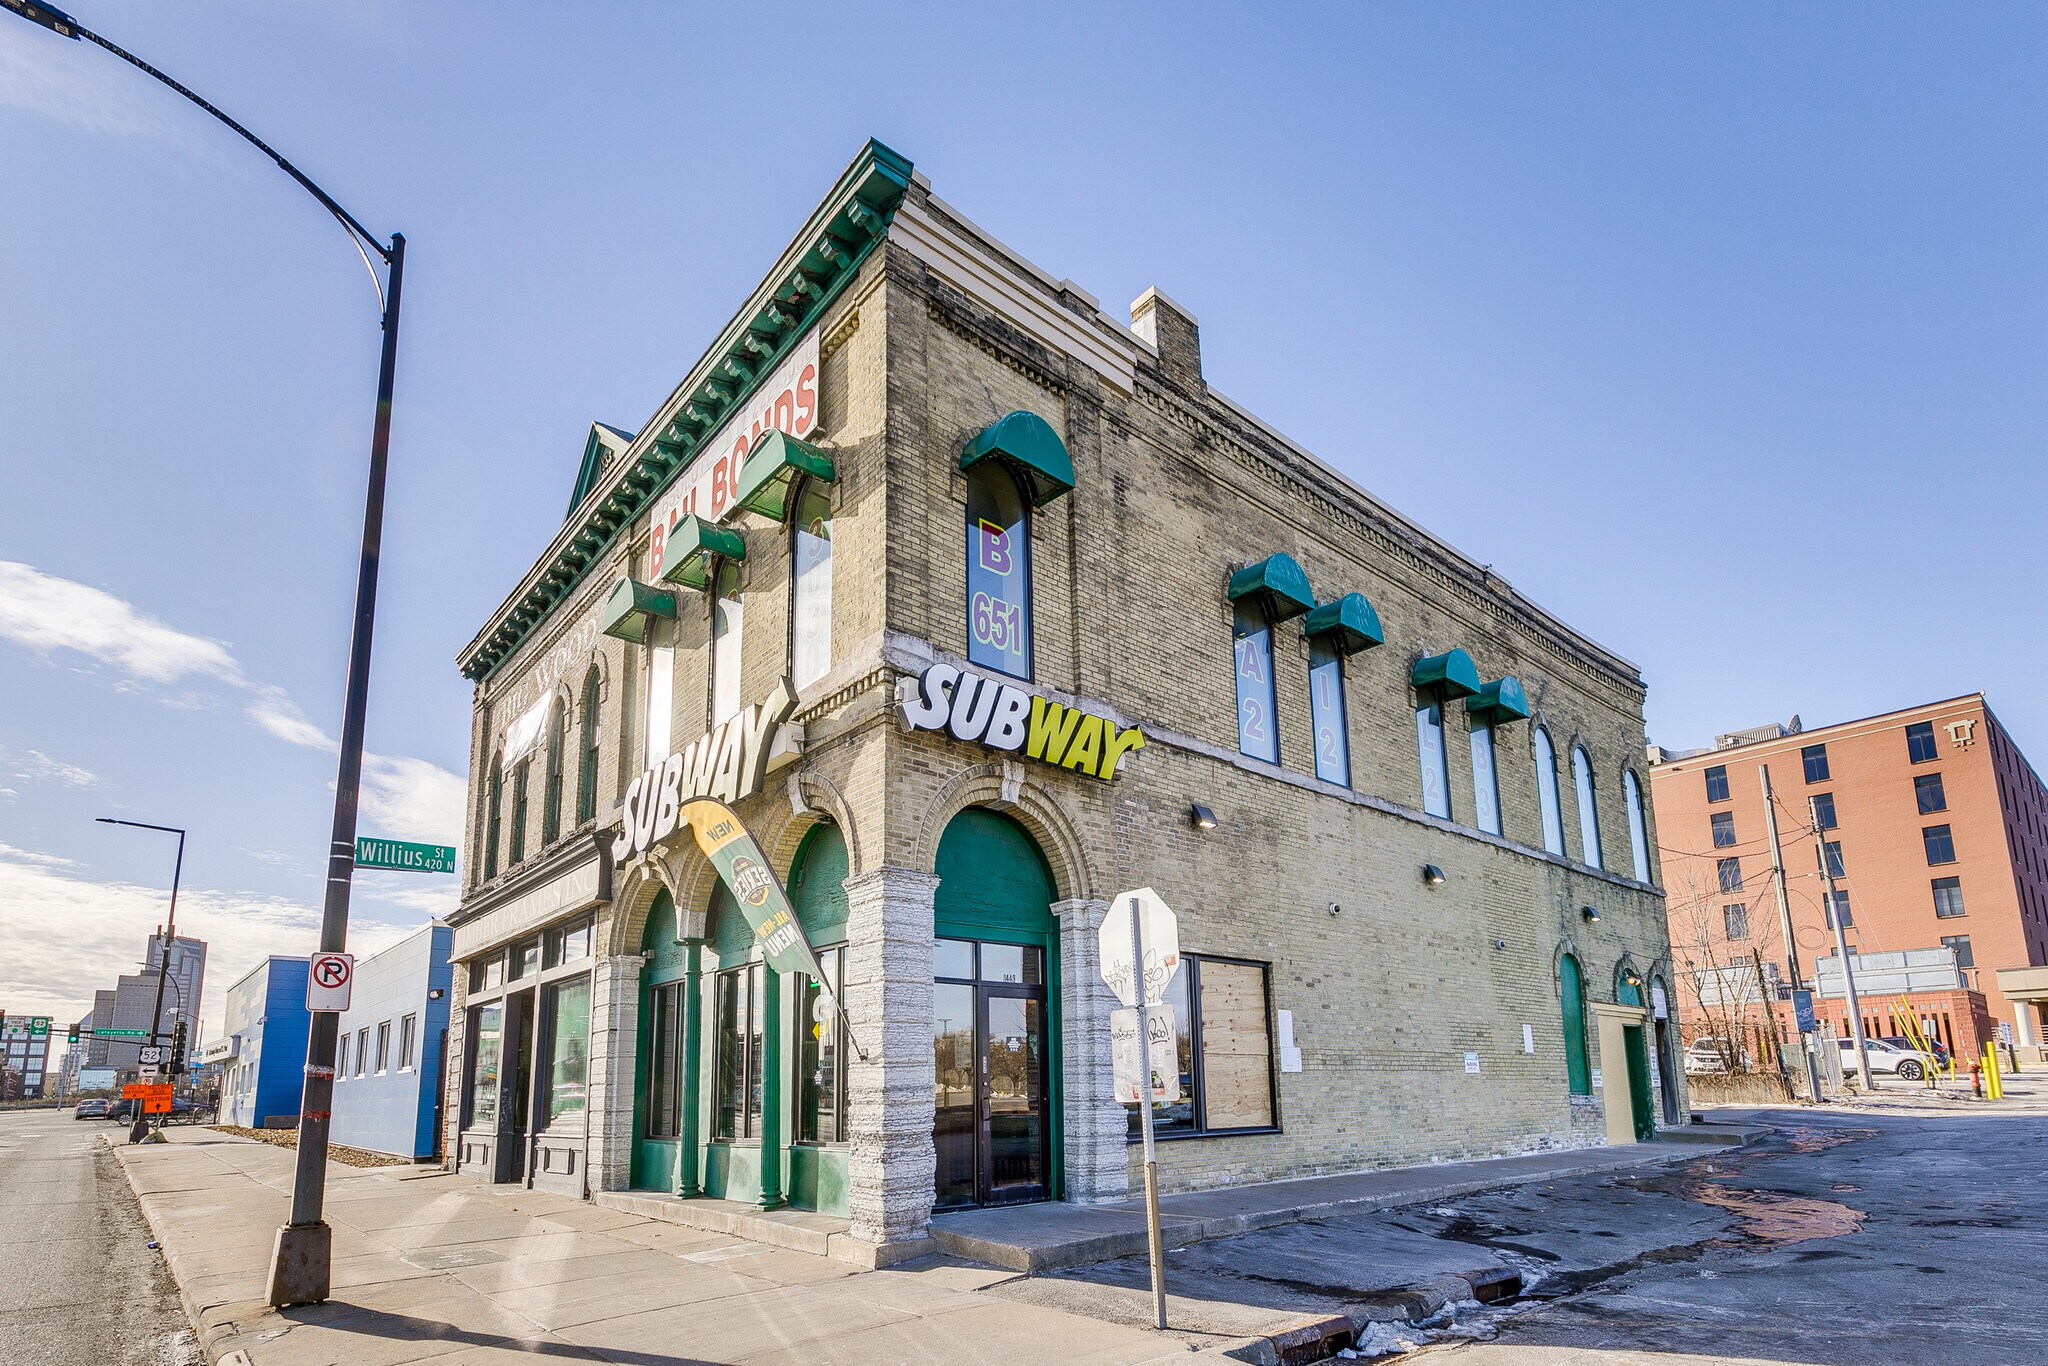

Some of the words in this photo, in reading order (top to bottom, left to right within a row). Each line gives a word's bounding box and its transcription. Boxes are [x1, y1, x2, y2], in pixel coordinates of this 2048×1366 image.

[979, 518, 1012, 576] B
[972, 591, 1022, 656] 651
[1240, 640, 1265, 684] A
[896, 663, 1146, 781] SUBWAY
[1243, 697, 1265, 742] 2
[1320, 727, 1338, 767] 2
[611, 675, 798, 869] SUBWAY
[1424, 765, 1440, 801] 2
[1477, 786, 1492, 820] 3
[360, 840, 423, 867] Willius
[434, 847, 445, 859] St
[424, 858, 443, 871] 420
[446, 862, 454, 872] N
[502, 884, 561, 931] FRAMES
[564, 863, 598, 901] INC
[143, 1050, 157, 1060] 52
